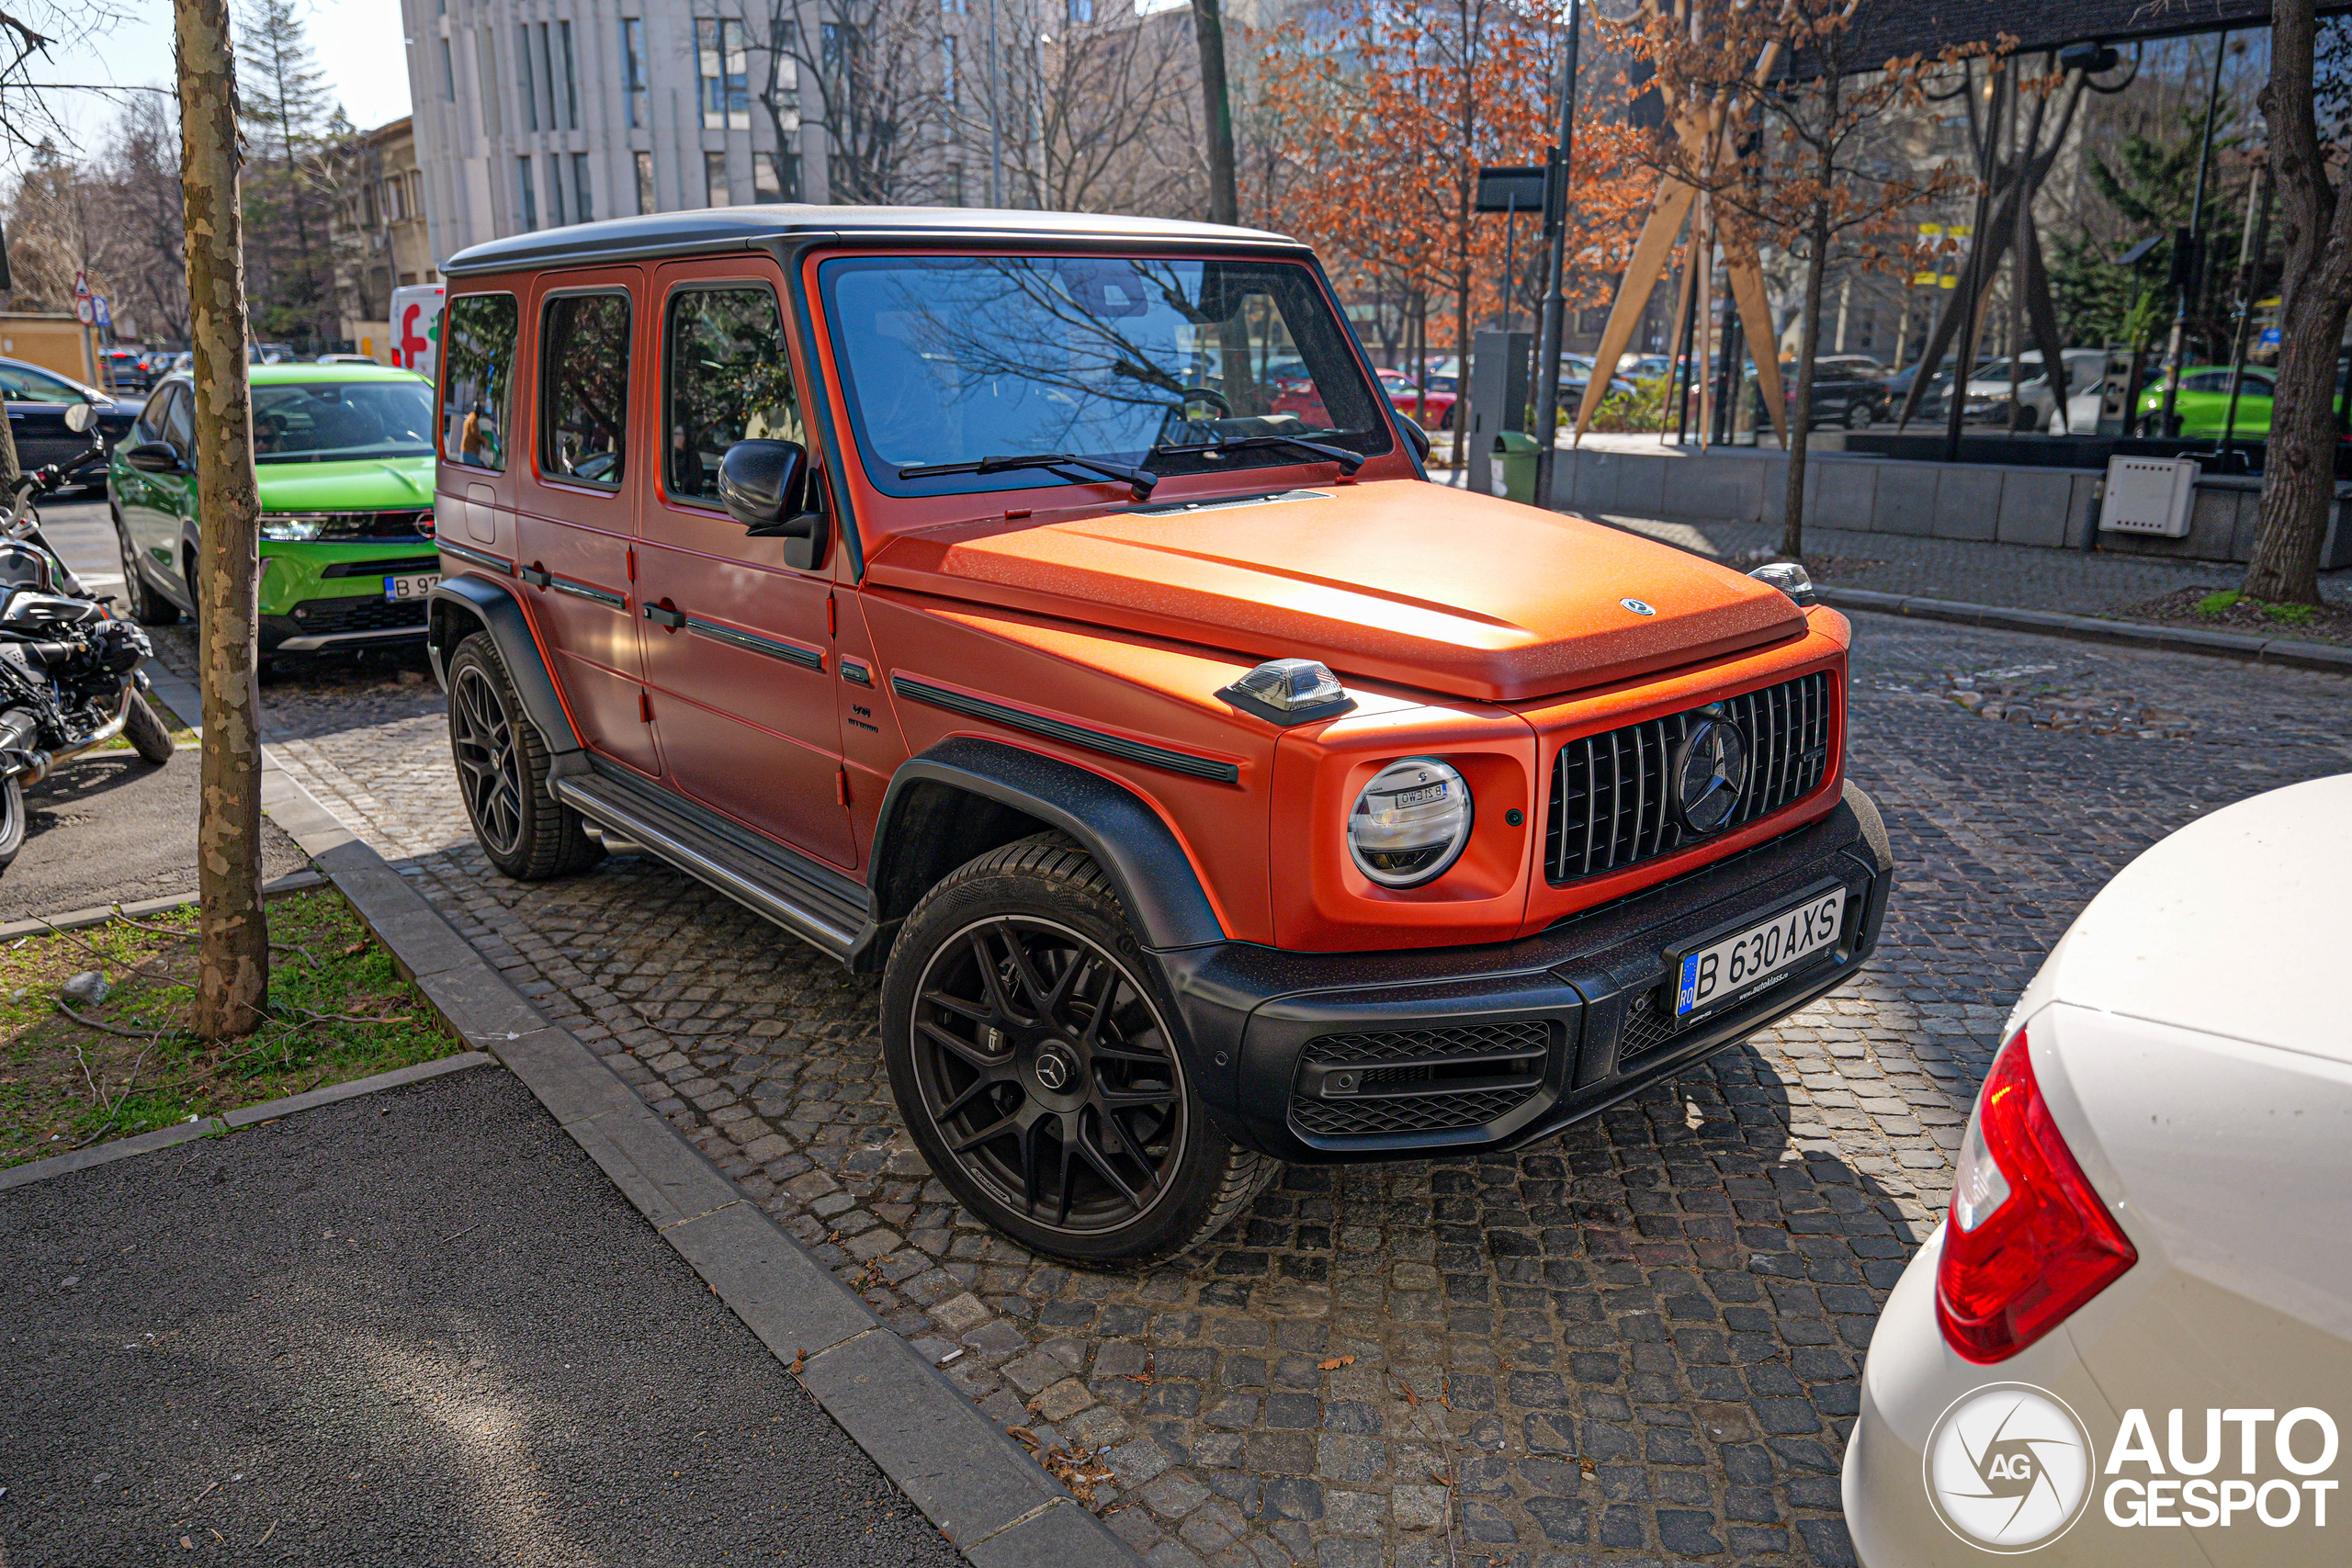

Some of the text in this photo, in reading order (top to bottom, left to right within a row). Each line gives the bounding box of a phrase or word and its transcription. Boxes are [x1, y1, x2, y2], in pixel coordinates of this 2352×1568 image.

[396, 580, 410, 596] B
[417, 576, 443, 594] 97
[852, 704, 871, 717] V8
[1696, 897, 1837, 1001] B 630 AXS
[1738, 972, 1789, 1001] www.autoklass.ro
[1679, 987, 1694, 1008] RO
